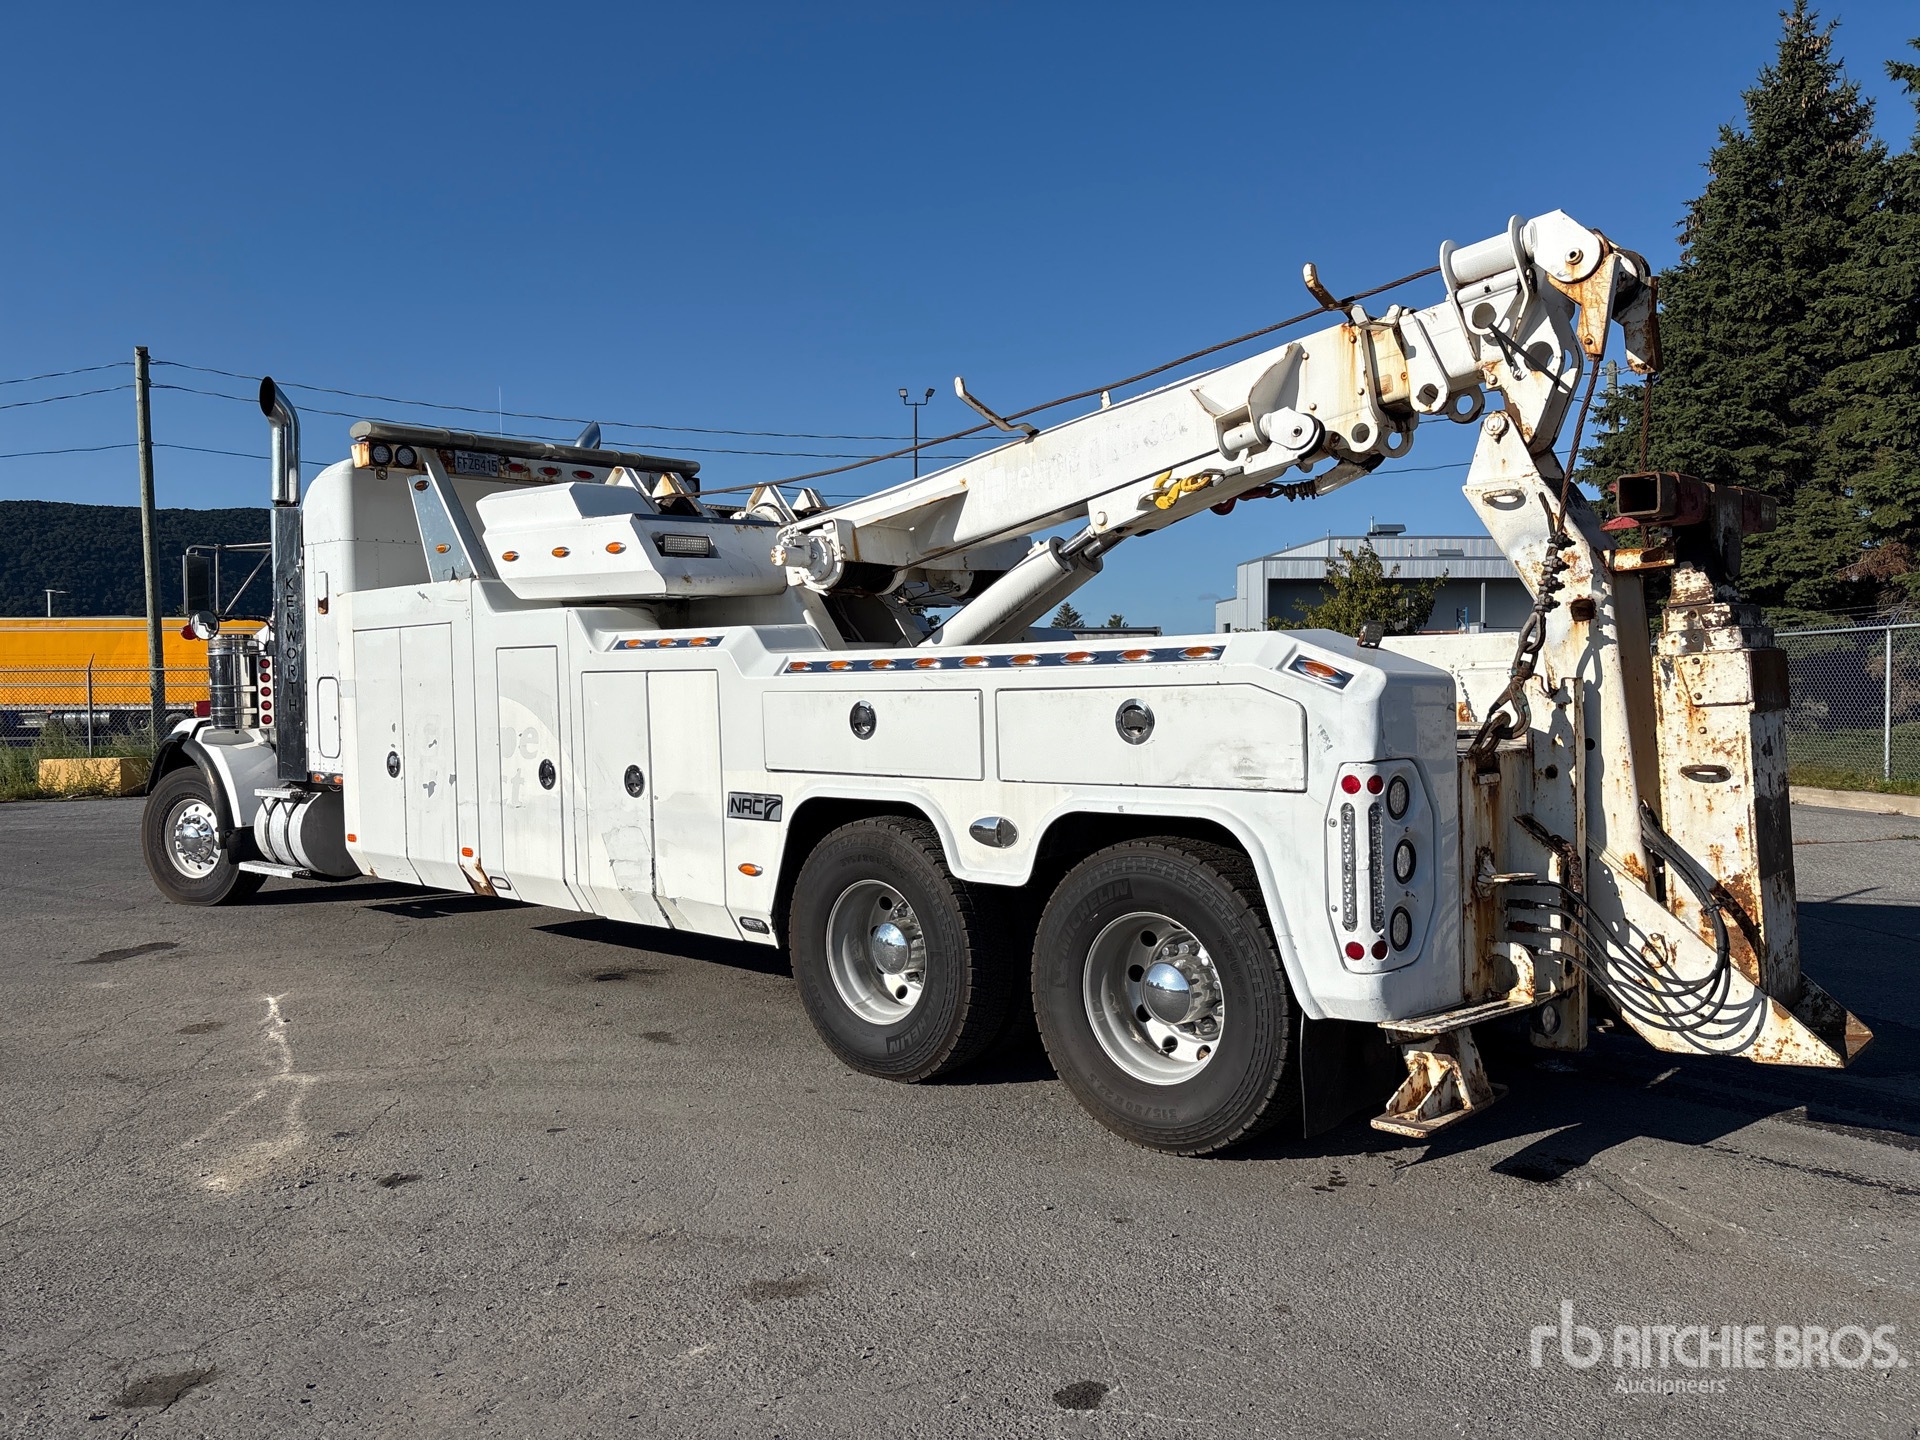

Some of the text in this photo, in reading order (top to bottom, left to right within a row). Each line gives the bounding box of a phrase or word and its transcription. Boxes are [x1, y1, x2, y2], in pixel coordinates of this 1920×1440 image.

[457, 456, 498, 472] FFZ6415
[285, 577, 297, 711] KENWORTH
[730, 797, 764, 815] NRC
[1061, 879, 1130, 957] MICHELIN
